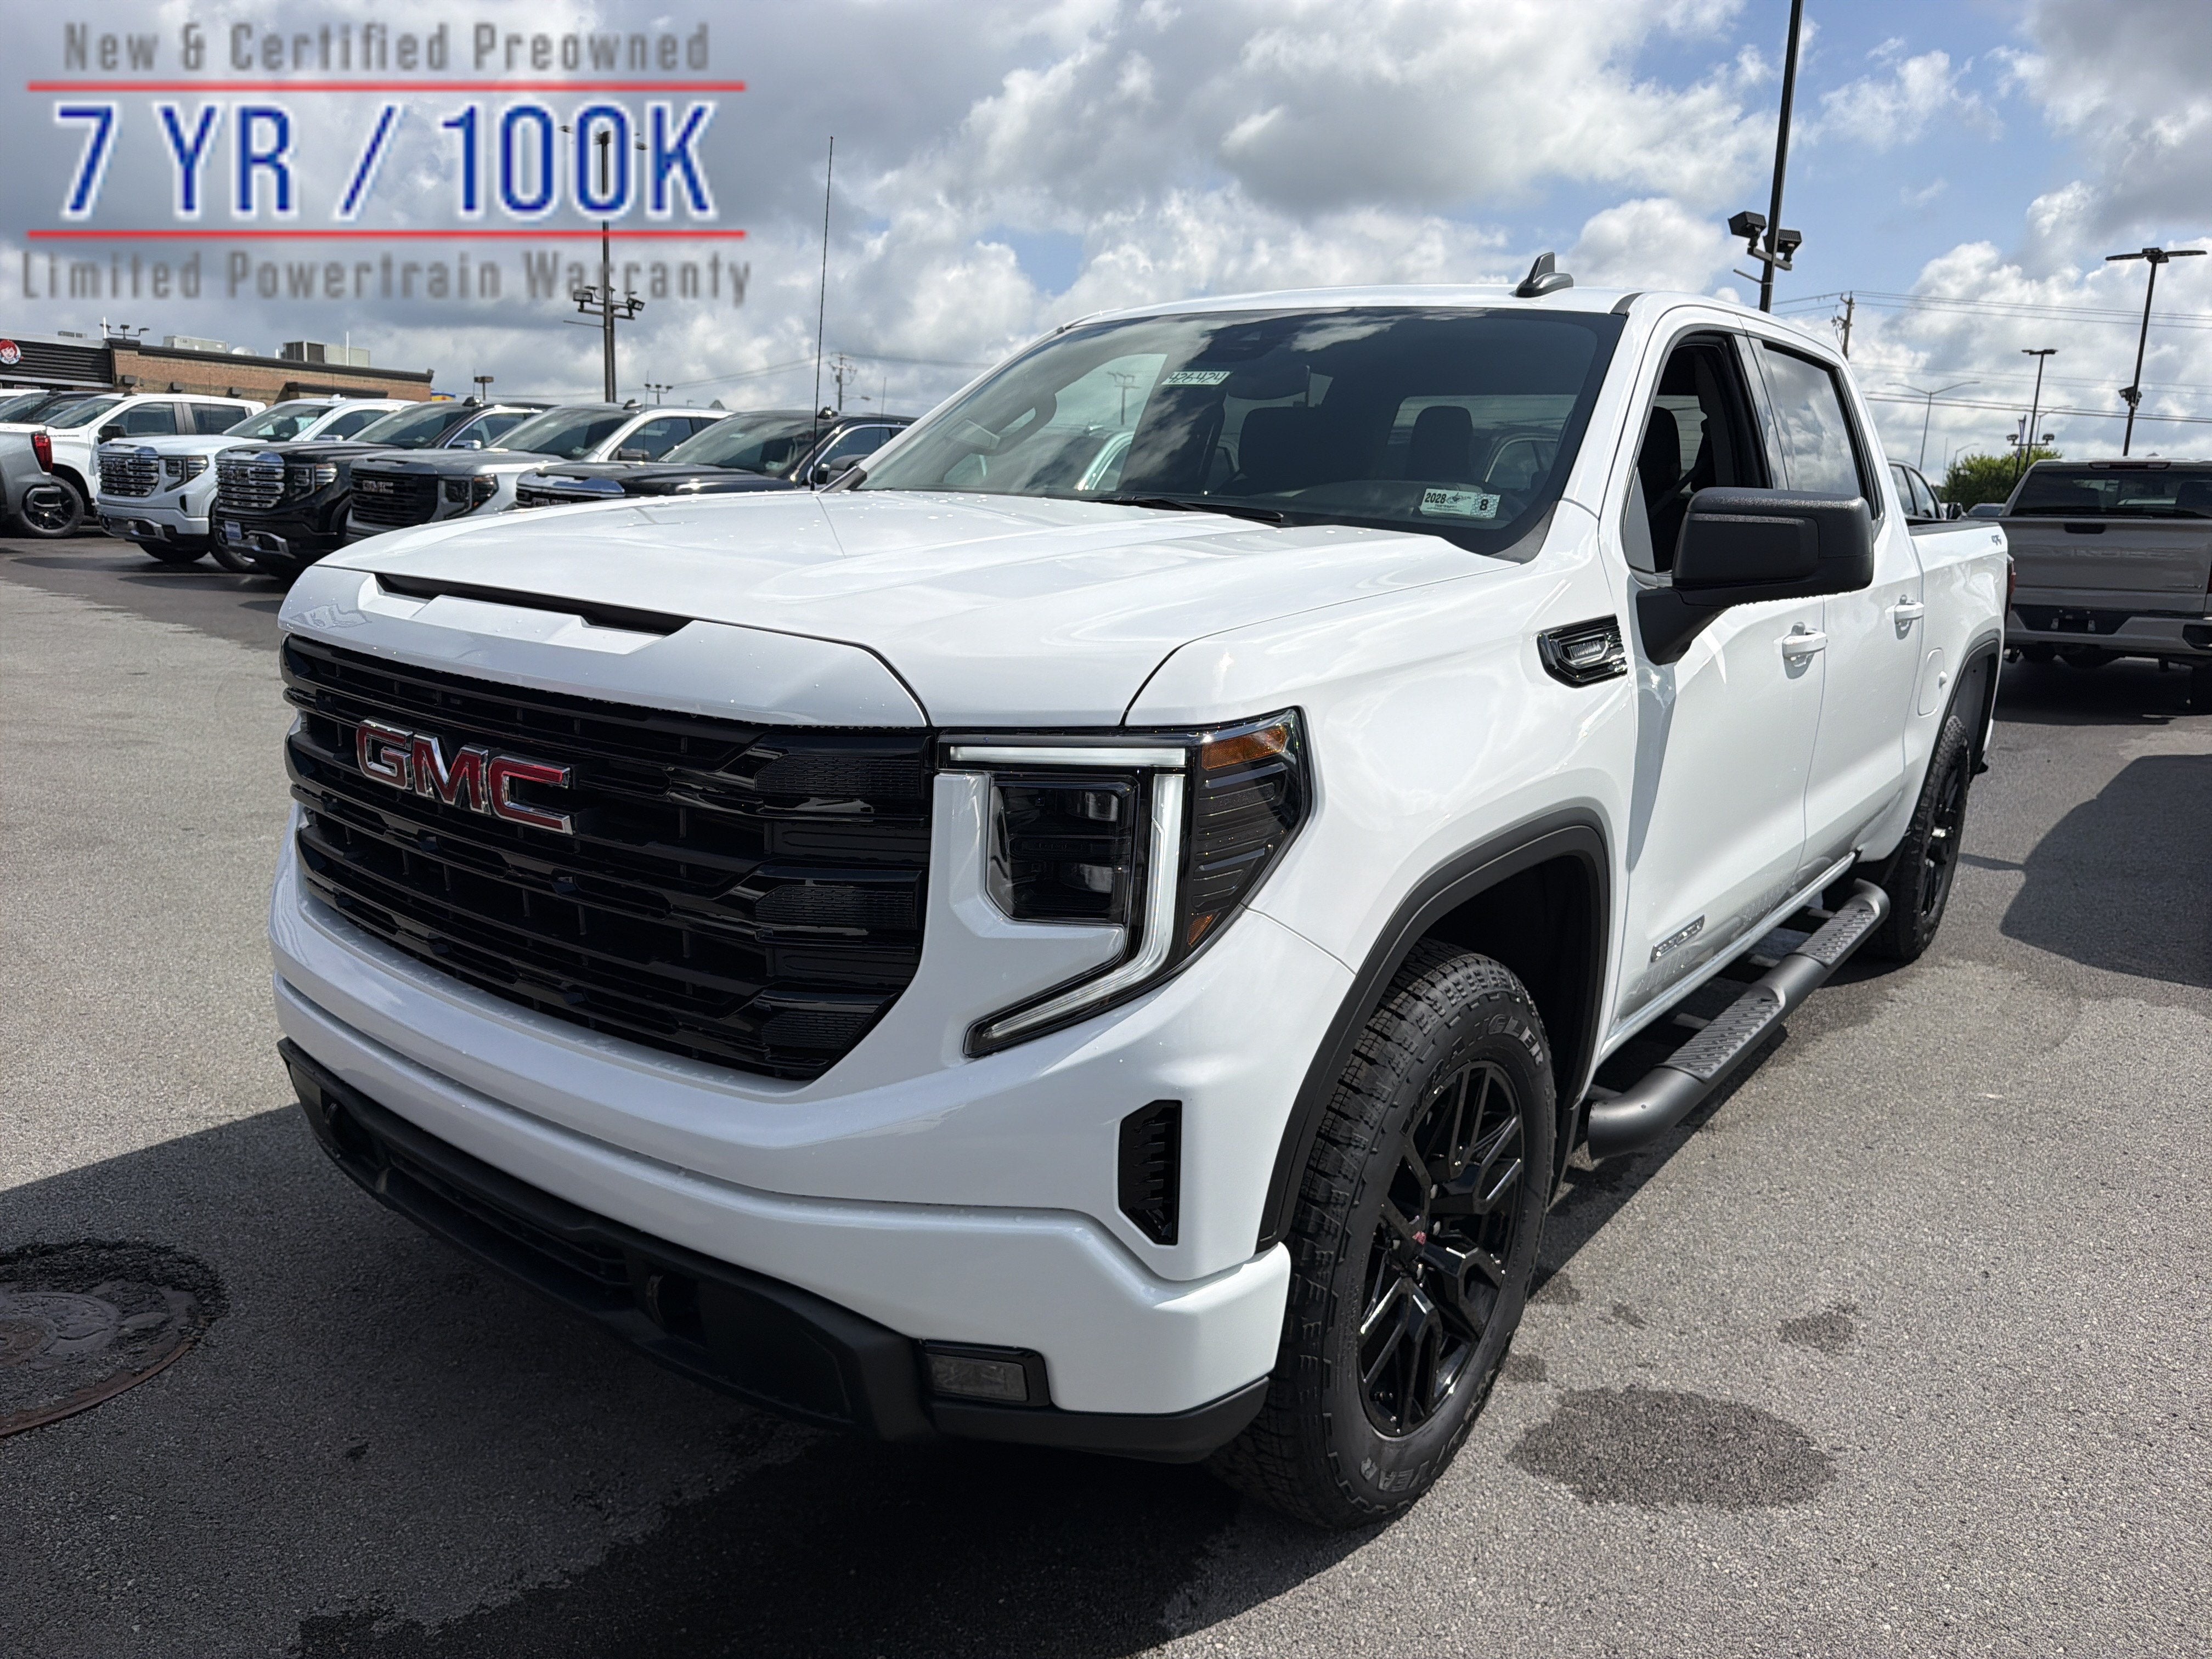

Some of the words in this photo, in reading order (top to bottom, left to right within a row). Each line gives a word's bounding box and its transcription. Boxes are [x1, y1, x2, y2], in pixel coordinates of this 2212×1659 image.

[1424, 492, 1447, 504] 2028
[1479, 499, 1489, 511] 8
[356, 718, 574, 835] GMC
